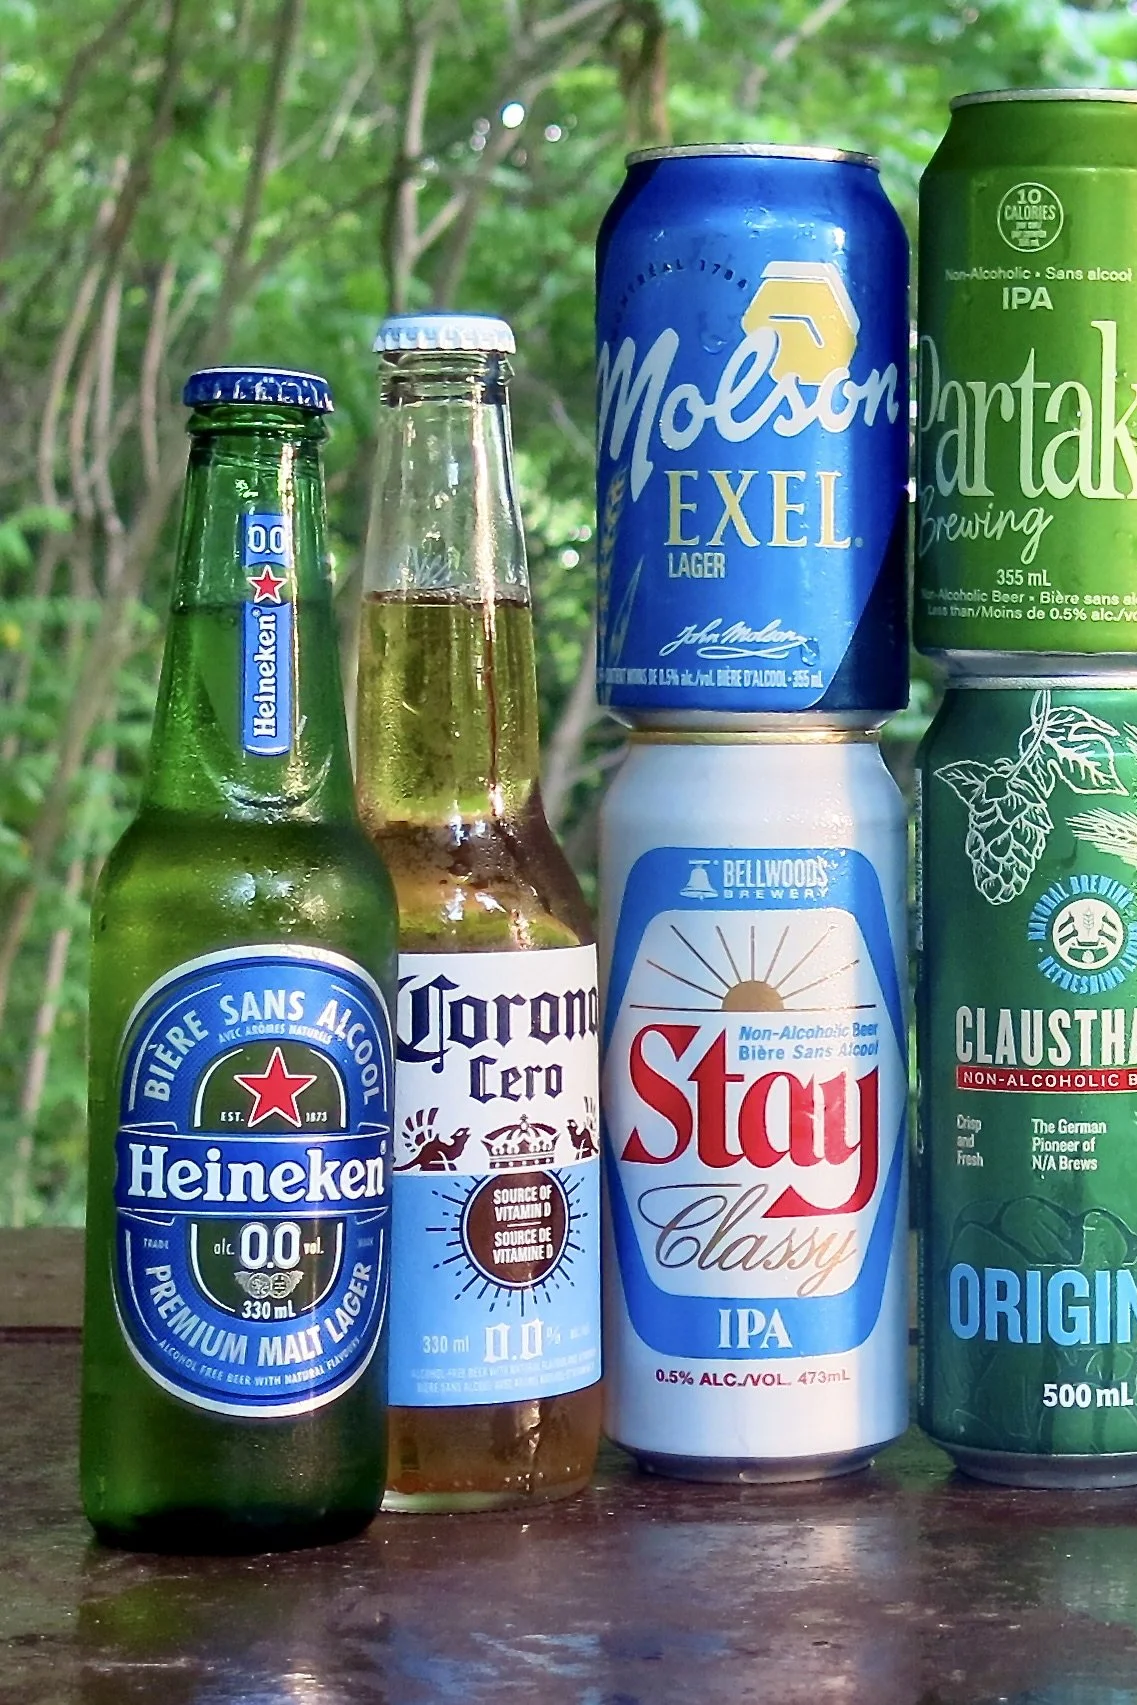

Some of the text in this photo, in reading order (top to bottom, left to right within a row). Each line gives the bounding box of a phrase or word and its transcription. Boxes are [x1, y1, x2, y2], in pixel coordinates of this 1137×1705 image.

[1017, 189, 1041, 205] 10
[1004, 205, 1056, 220] CALORIES
[1045, 267, 1133, 282] Sans alcool
[1002, 286, 1054, 311] IPA
[596, 327, 899, 503] Molson
[664, 470, 851, 548] EXEL
[918, 483, 1053, 565] Brewing
[668, 552, 726, 579] LAGER
[997, 569, 1051, 587] 355 mL
[991, 590, 1025, 604] Beer
[1039, 590, 1080, 605] Bière
[1083, 594, 1119, 606] sans
[1026, 606, 1087, 621] de 0.5%
[252, 614, 277, 737] Heineken
[723, 858, 828, 888] BELLWOODS
[723, 888, 829, 899] BREWERY
[739, 1022, 878, 1042] Non-Alcoholic Beer
[144, 989, 379, 1105] BIÈRE SANS ALCOOL
[738, 1040, 879, 1061] Bière Sans Alcool
[469, 1054, 563, 1104] Cero
[963, 1070, 1120, 1088] NON-ALCOHOLIC
[220, 1112, 328, 1123] EST. 1873
[620, 1024, 879, 1218] Stay
[957, 1115, 982, 1133] Crisp
[1031, 1118, 1107, 1135] The German
[957, 1134, 975, 1149] and
[1031, 1137, 1096, 1153] Pioneer of
[956, 1152, 984, 1168] Fresh
[1031, 1155, 1098, 1172] N/A Brews
[127, 1143, 385, 1202] Heineken
[493, 1184, 553, 1205] SOURCE OF
[494, 1202, 552, 1223] VITAMIN D
[213, 1221, 325, 1269] alc. 0.0 vol.
[494, 1227, 552, 1248] SOURCE DE
[637, 1183, 857, 1297] Classy
[493, 1244, 553, 1265] VITAMINE D
[145, 1262, 373, 1367] PREMIUM MALT LAGER
[241, 1300, 297, 1319] 330 mL
[717, 1308, 793, 1350] IPA
[423, 1335, 469, 1354] 330 ml
[158, 1339, 197, 1373] ALCOHOL
[201, 1365, 223, 1382] FREE
[227, 1372, 250, 1387] BEER
[255, 1376, 281, 1387] WITH
[655, 1369, 851, 1387] 0.5% ALC./VOL. 473mL
[1042, 1382, 1134, 1408] 500 mL
